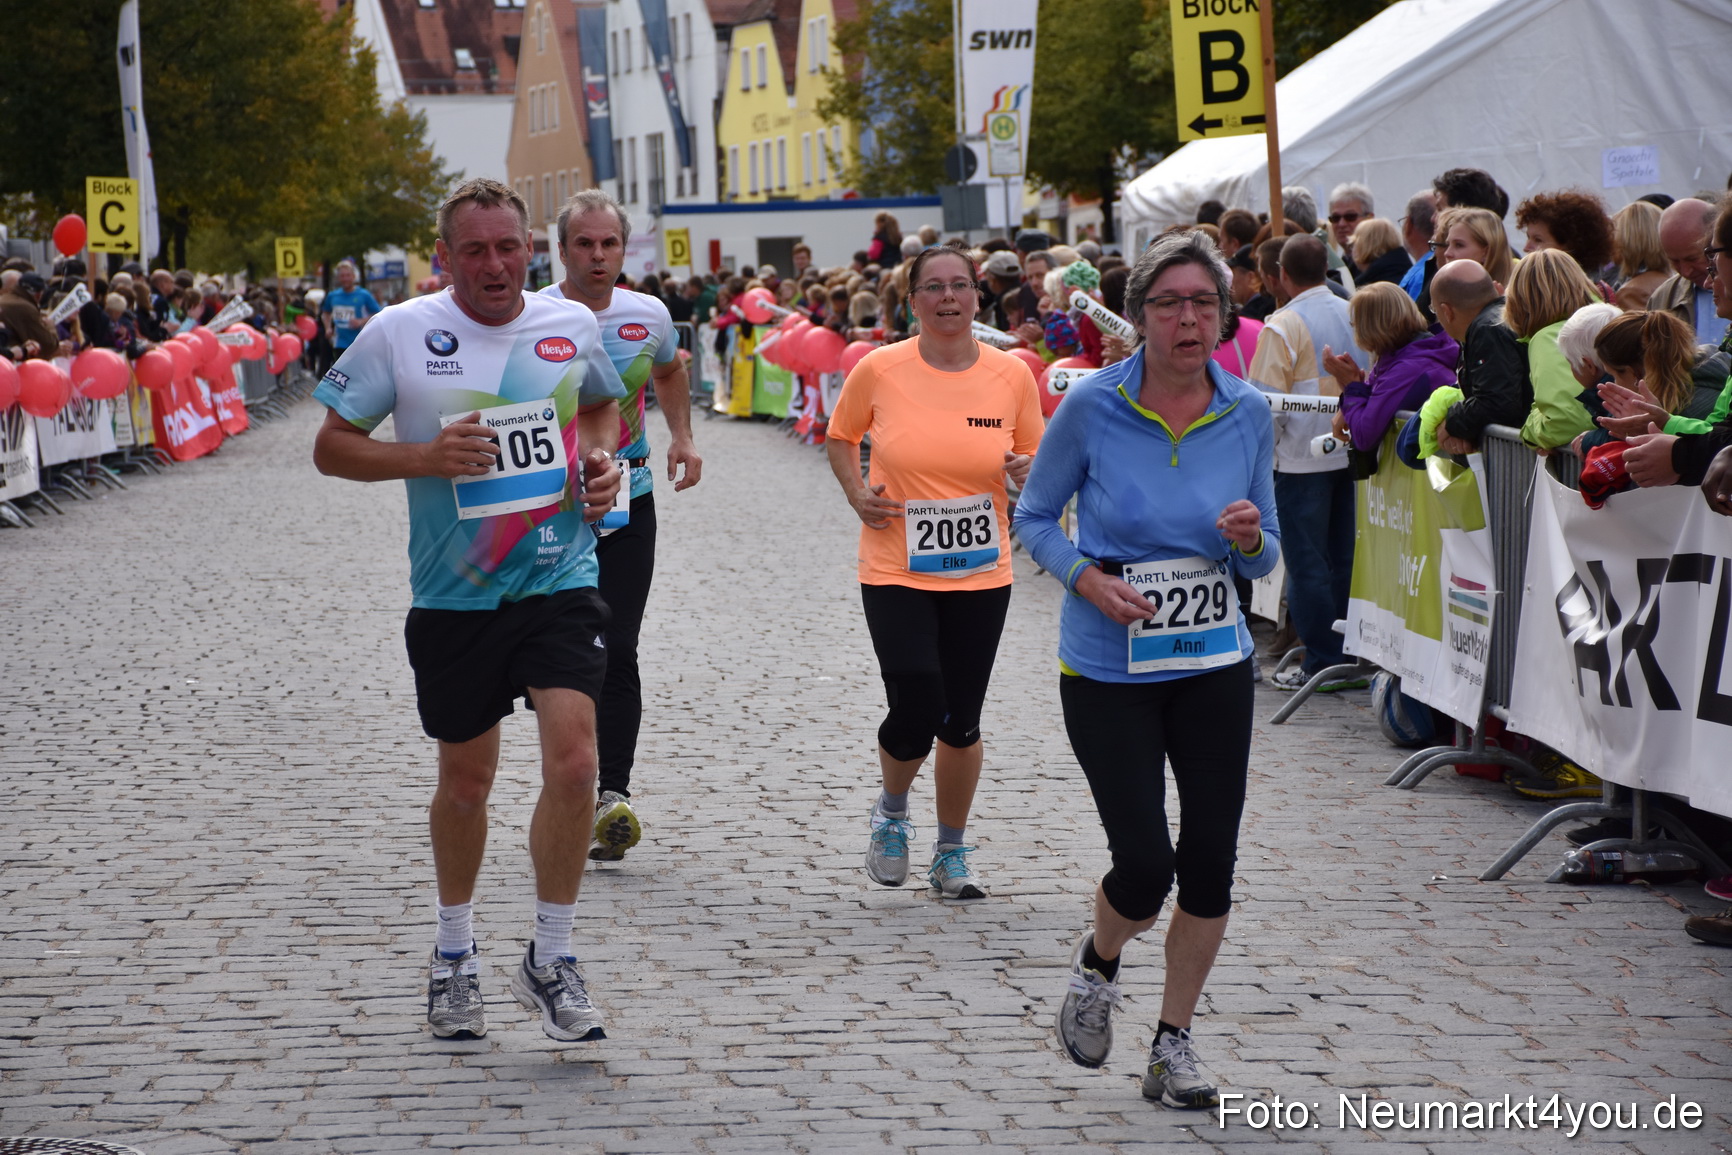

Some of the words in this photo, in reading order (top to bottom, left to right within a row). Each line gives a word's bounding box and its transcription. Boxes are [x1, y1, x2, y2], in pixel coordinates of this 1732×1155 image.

[1183, 0, 1260, 18] Block
[969, 28, 1033, 51] swn
[1198, 28, 1251, 105] B
[92, 180, 132, 196] Block
[99, 200, 126, 237] C
[671, 239, 686, 259] D
[283, 249, 298, 269] D
[1091, 307, 1123, 332] BMW
[619, 327, 647, 337] Hervis
[540, 343, 573, 356] Hervis
[426, 360, 463, 370] PARTL
[486, 412, 539, 428] Neumarkt
[966, 417, 1003, 429] THULE
[485, 426, 556, 472] 105
[907, 507, 940, 517] PARTL
[941, 503, 981, 515] Neumarkt
[538, 525, 558, 543] 16.
[916, 514, 992, 551] 2083
[942, 557, 967, 569] Elke
[1127, 572, 1170, 585] PARTL
[1171, 566, 1218, 581] Neumarkt
[1141, 580, 1228, 631] 2229
[1172, 636, 1206, 654] Anni
